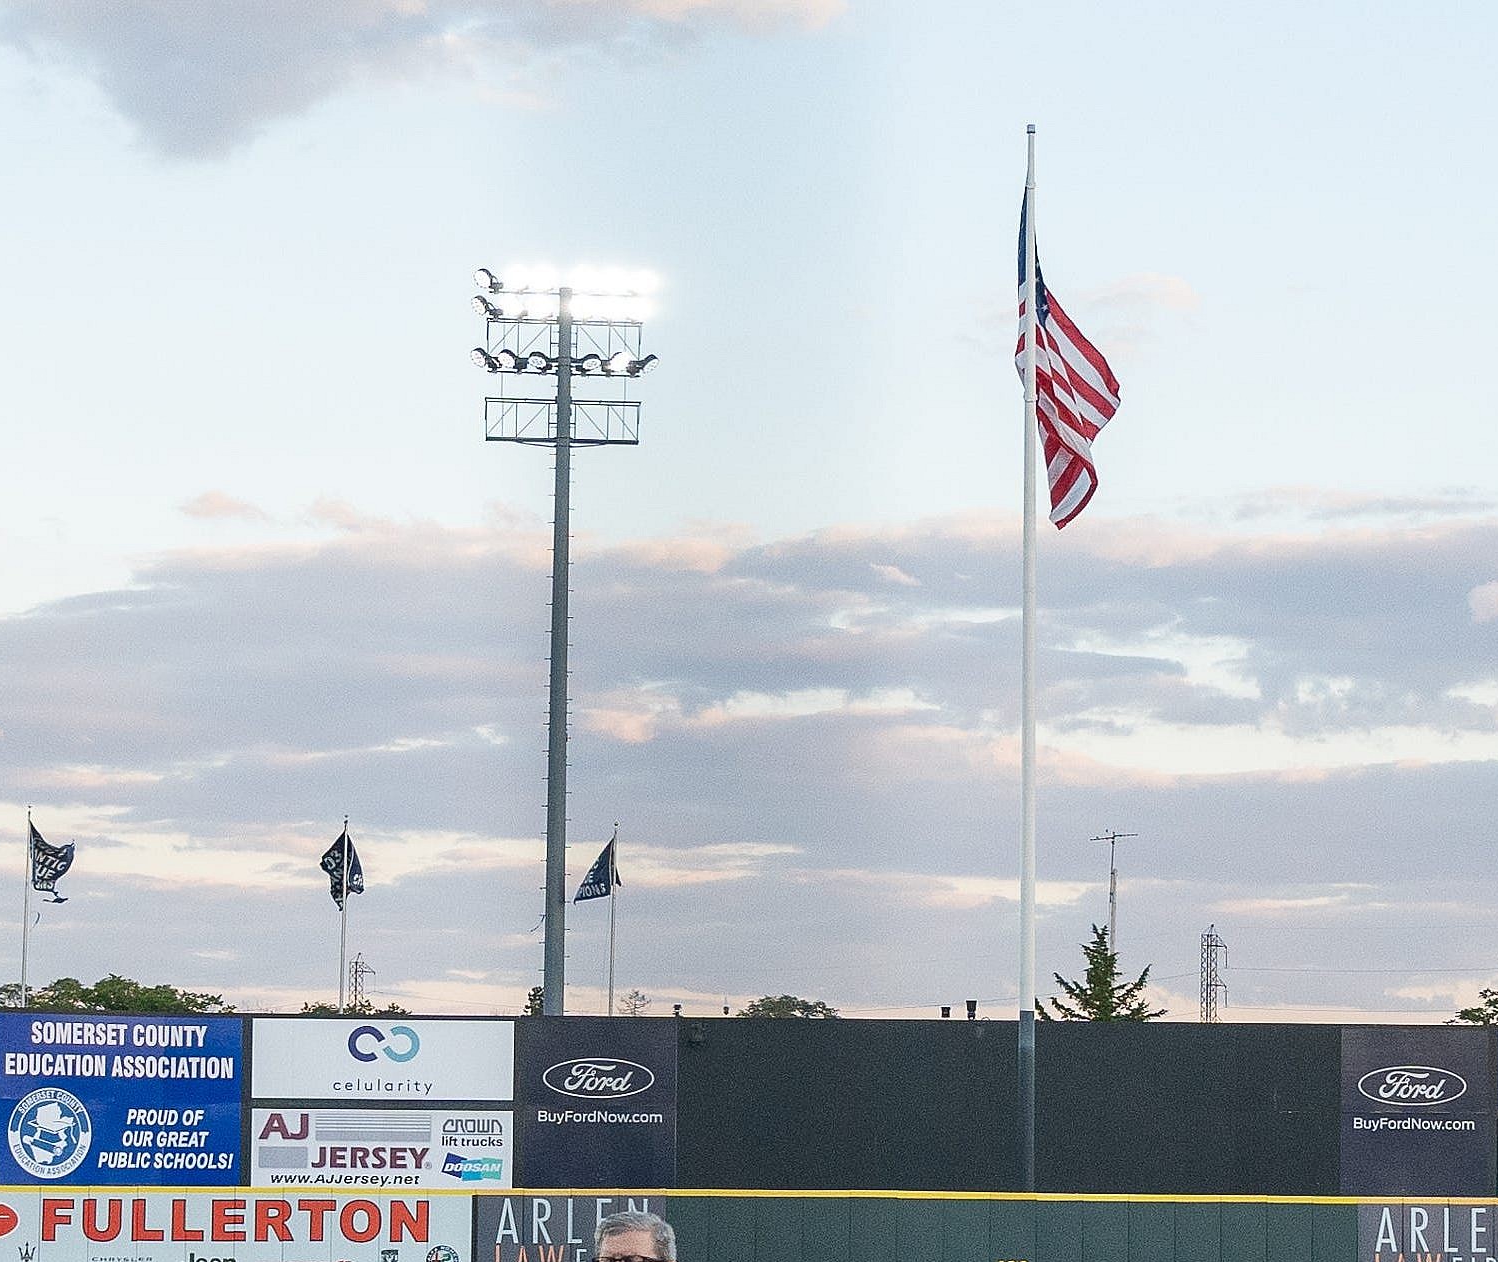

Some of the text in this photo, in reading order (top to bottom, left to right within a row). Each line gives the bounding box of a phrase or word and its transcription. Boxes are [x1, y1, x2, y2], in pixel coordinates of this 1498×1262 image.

[31, 1022, 207, 1048] SOMERSET COUNTY
[5, 1052, 234, 1080] EDUCATION ASSOCIATION
[564, 1063, 634, 1092] Ford
[1379, 1071, 1446, 1099] Ford
[333, 1078, 433, 1096] celularity
[126, 1108, 205, 1126] PROUD OF
[537, 1110, 663, 1124] BuyFordNow.com
[1353, 1117, 1475, 1132] BuyFordNow.com
[258, 1113, 309, 1140] AJ
[121, 1130, 209, 1148] OUR GREAT
[441, 1136, 503, 1147] lift trucks
[97, 1151, 234, 1170] PUBLIC SCHOOLS!
[311, 1147, 430, 1170] JERSEY
[443, 1162, 501, 1172] DOOSAN
[271, 1174, 419, 1186] www.AJJersey.net
[41, 1198, 429, 1242] FULLERTON
